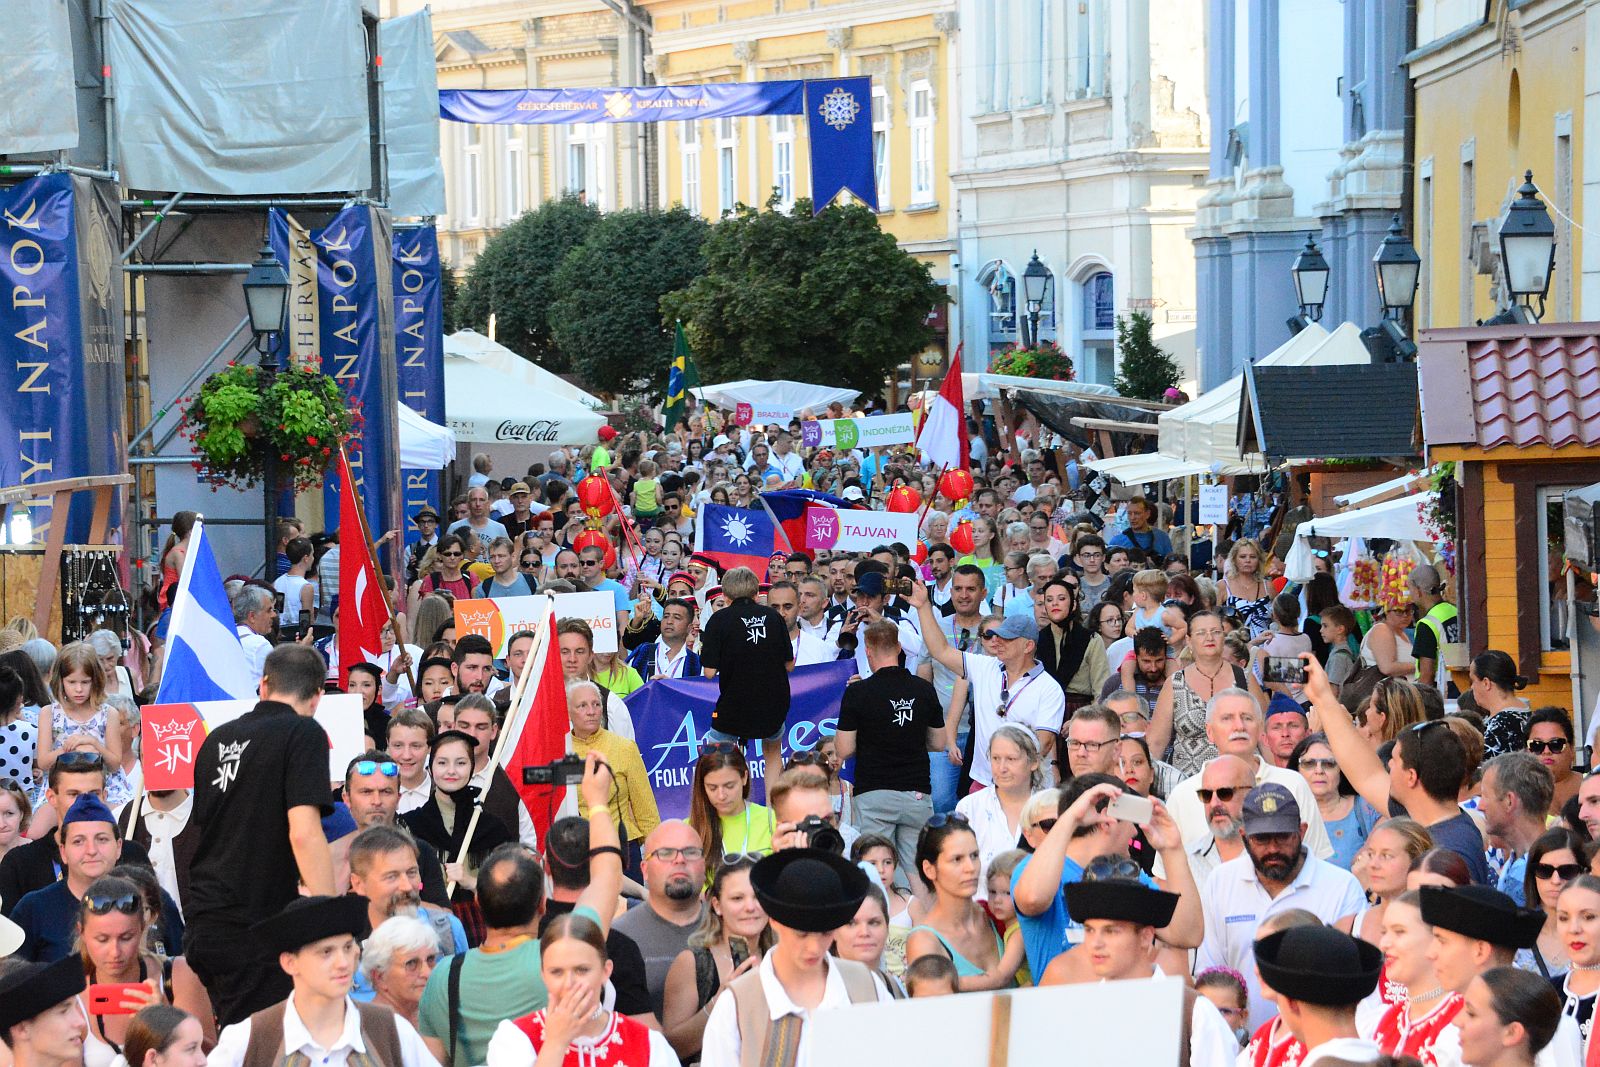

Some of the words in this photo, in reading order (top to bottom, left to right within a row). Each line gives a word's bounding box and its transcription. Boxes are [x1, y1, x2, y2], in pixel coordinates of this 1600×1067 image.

[4, 198, 51, 395] NAPOK
[324, 226, 360, 379] NAPOK
[400, 241, 426, 368] NAPOK
[496, 419, 562, 442] Coca-Cola
[863, 425, 911, 437] INDONÉZIA
[844, 525, 897, 539] TAJVAN
[655, 767, 690, 788] FOLK
